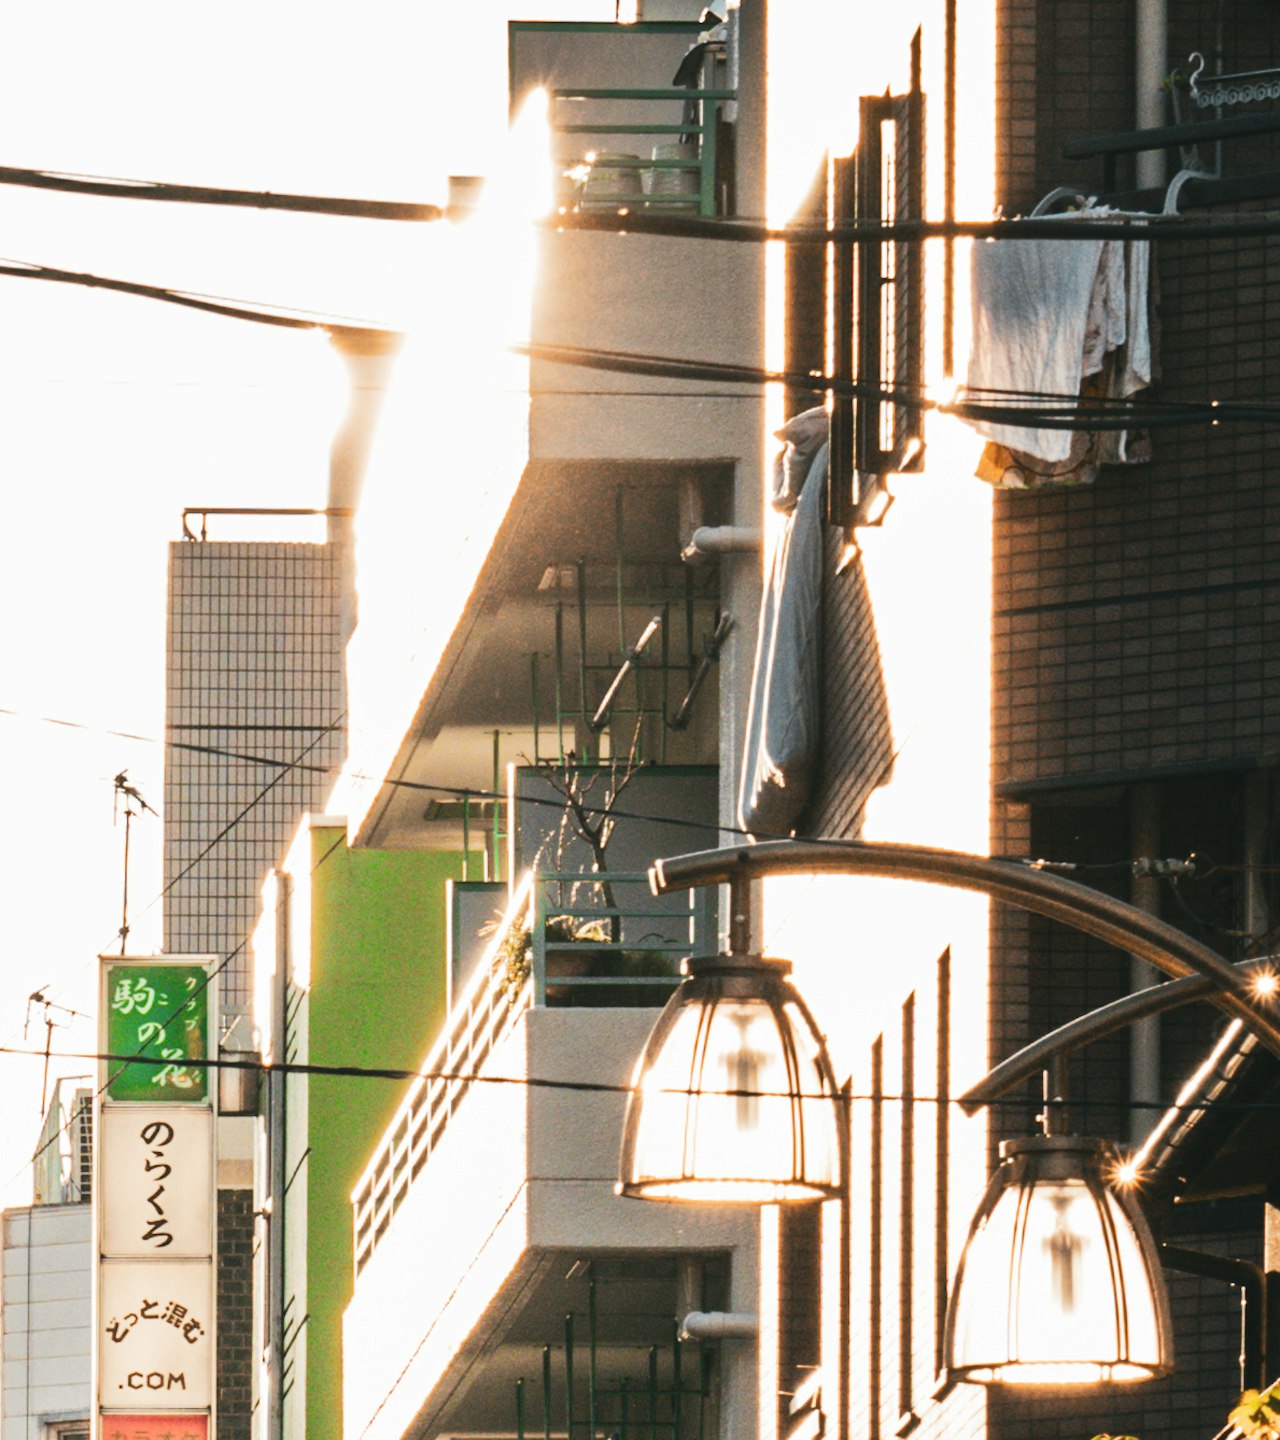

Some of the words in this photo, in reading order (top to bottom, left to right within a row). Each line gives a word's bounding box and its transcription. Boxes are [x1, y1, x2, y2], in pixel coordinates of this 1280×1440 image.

[140, 1121, 175, 1248] のらくろ
[105, 1298, 205, 1345] どっと混む
[118, 1371, 187, 1391] .COM
